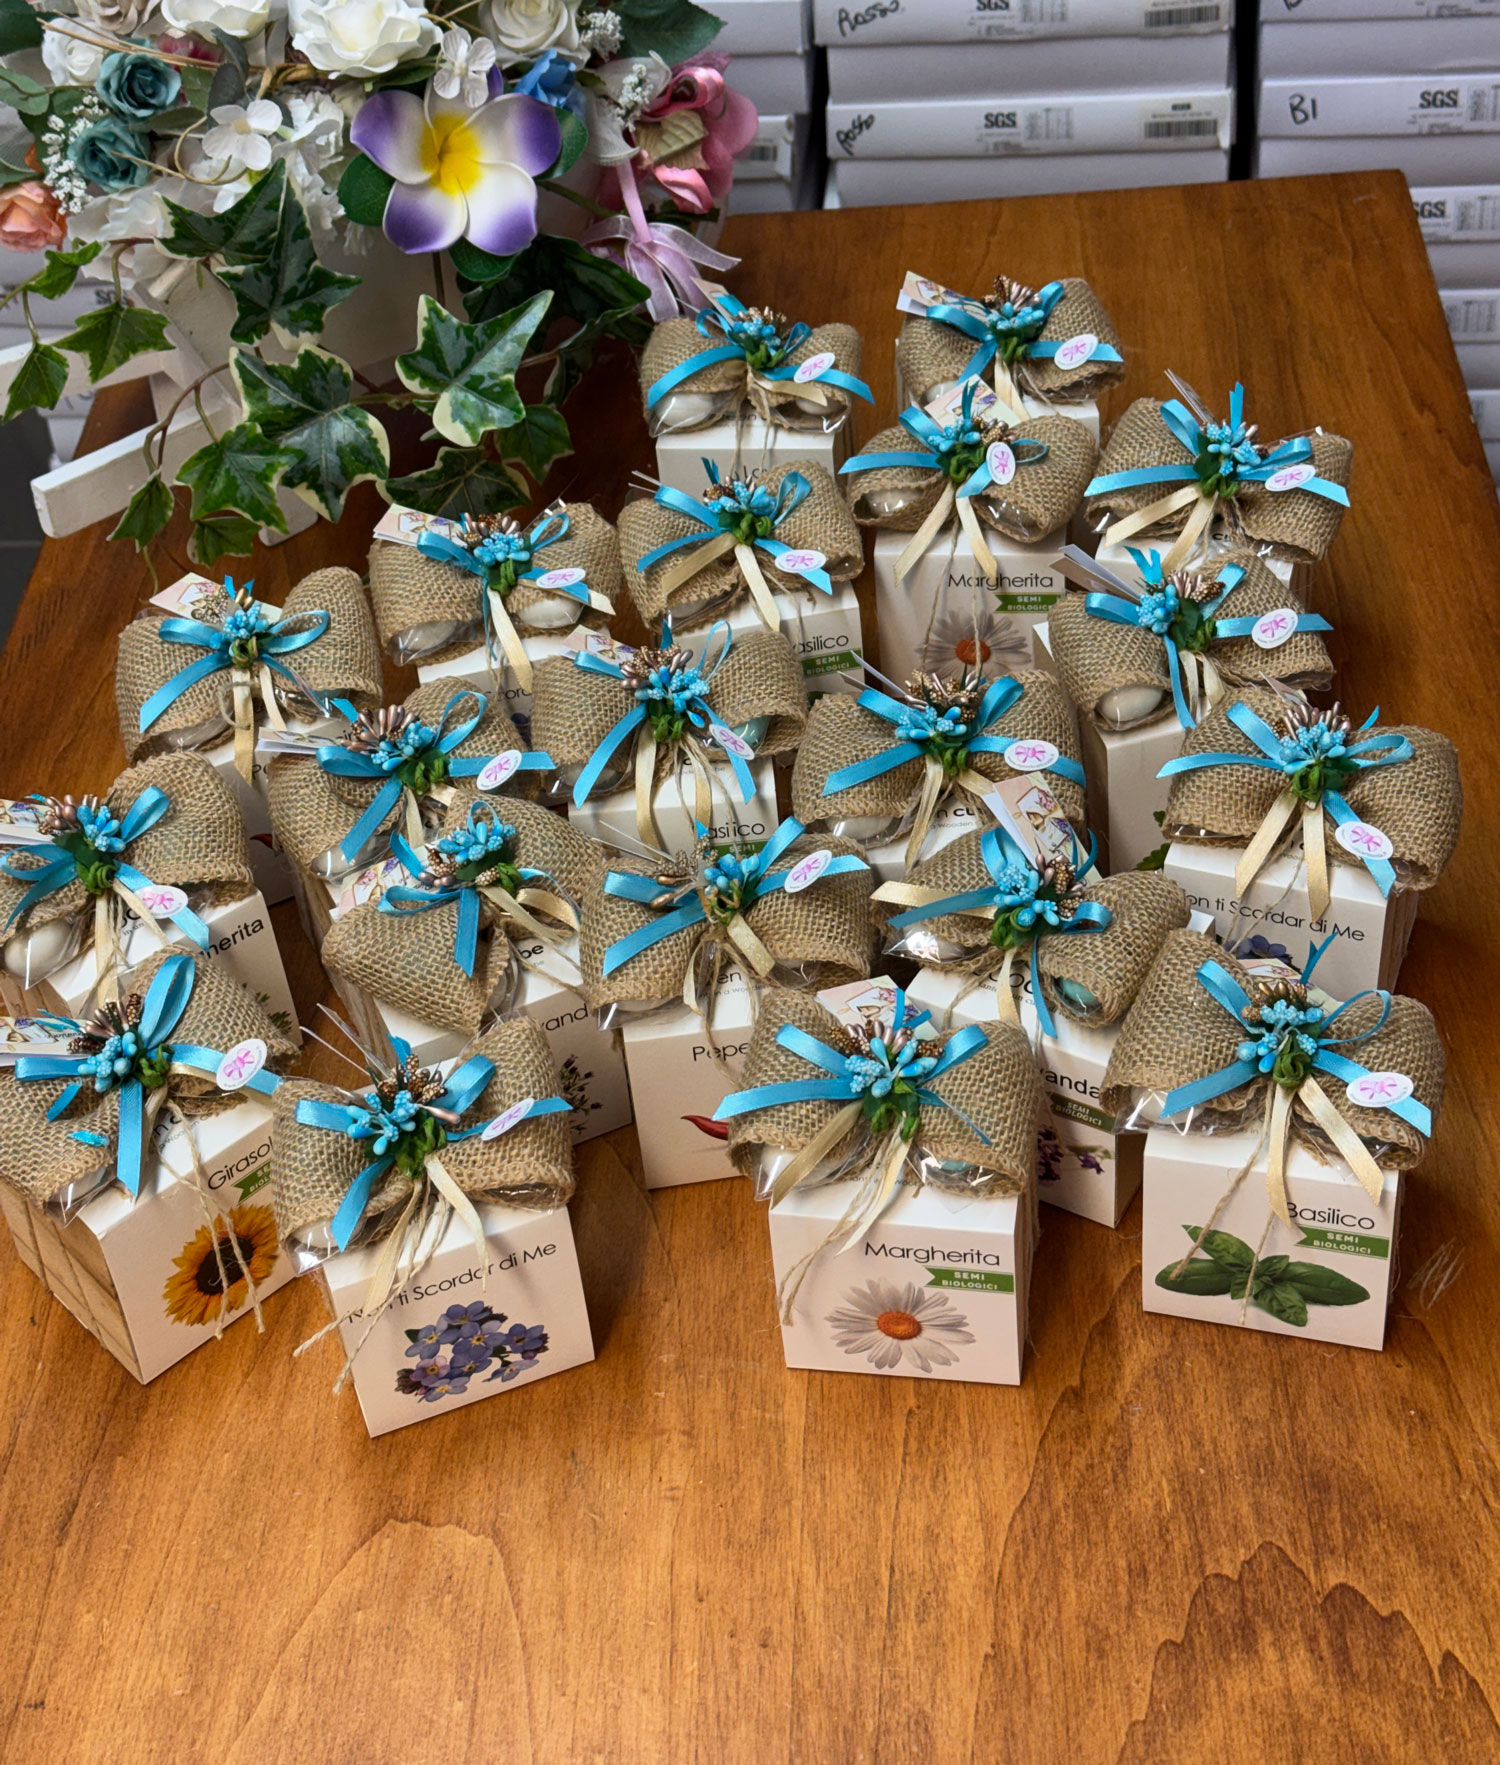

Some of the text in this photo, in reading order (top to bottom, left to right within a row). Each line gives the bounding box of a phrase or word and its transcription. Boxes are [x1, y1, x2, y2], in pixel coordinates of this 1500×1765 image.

[976, 0, 1010, 11] SGS
[1419, 88, 1459, 109] SGS
[984, 112, 1017, 129] SGS
[948, 572, 1053, 591] Margherita
[1017, 595, 1041, 603] SEMI
[793, 635, 849, 655] asilico
[815, 655, 840, 665] SEMI
[706, 821, 766, 840] asiico
[1186, 894, 1210, 908] on
[1215, 898, 1225, 911] ti
[1309, 919, 1328, 934] di
[1332, 923, 1366, 942] Me
[1040, 1068, 1100, 1099] anda
[1055, 1105, 1102, 1126] BIOLOGICI
[1067, 1102, 1090, 1115] SEMI
[208, 1135, 273, 1190] Girasol
[1287, 1202, 1375, 1230] Basilico
[1313, 1239, 1371, 1254] BIOLOGICI
[1326, 1232, 1359, 1243] SEMI
[500, 1252, 518, 1271] di
[523, 1243, 557, 1264] Me
[864, 1241, 1000, 1266] Margherita
[941, 1279, 998, 1290] BIOLOGICI
[954, 1271, 985, 1280] SEMI
